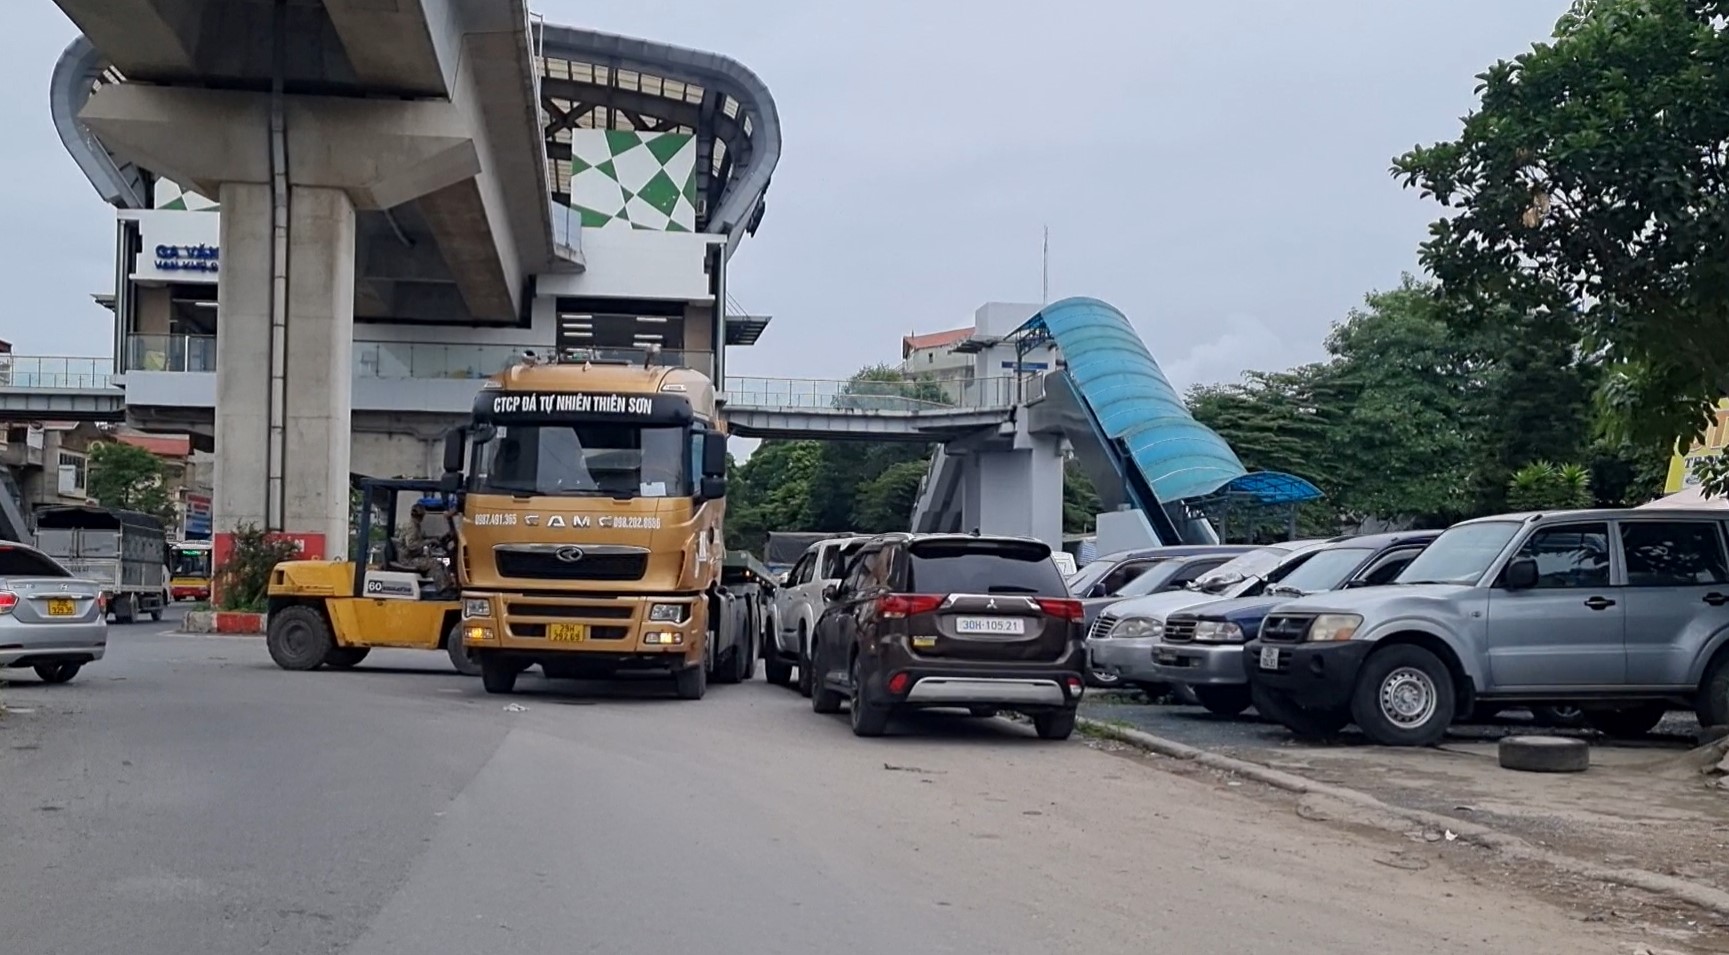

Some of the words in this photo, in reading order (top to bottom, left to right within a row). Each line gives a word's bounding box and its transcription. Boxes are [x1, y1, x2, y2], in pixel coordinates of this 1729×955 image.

[155, 244, 179, 259] GA
[493, 396, 520, 413] CTCP
[521, 392, 537, 412] ĐÁ
[539, 394, 555, 414] TỰ
[556, 392, 591, 412] NHIÊN
[593, 393, 626, 413] THIÊN
[628, 396, 653, 415] SƠN
[368, 581, 382, 591] 60
